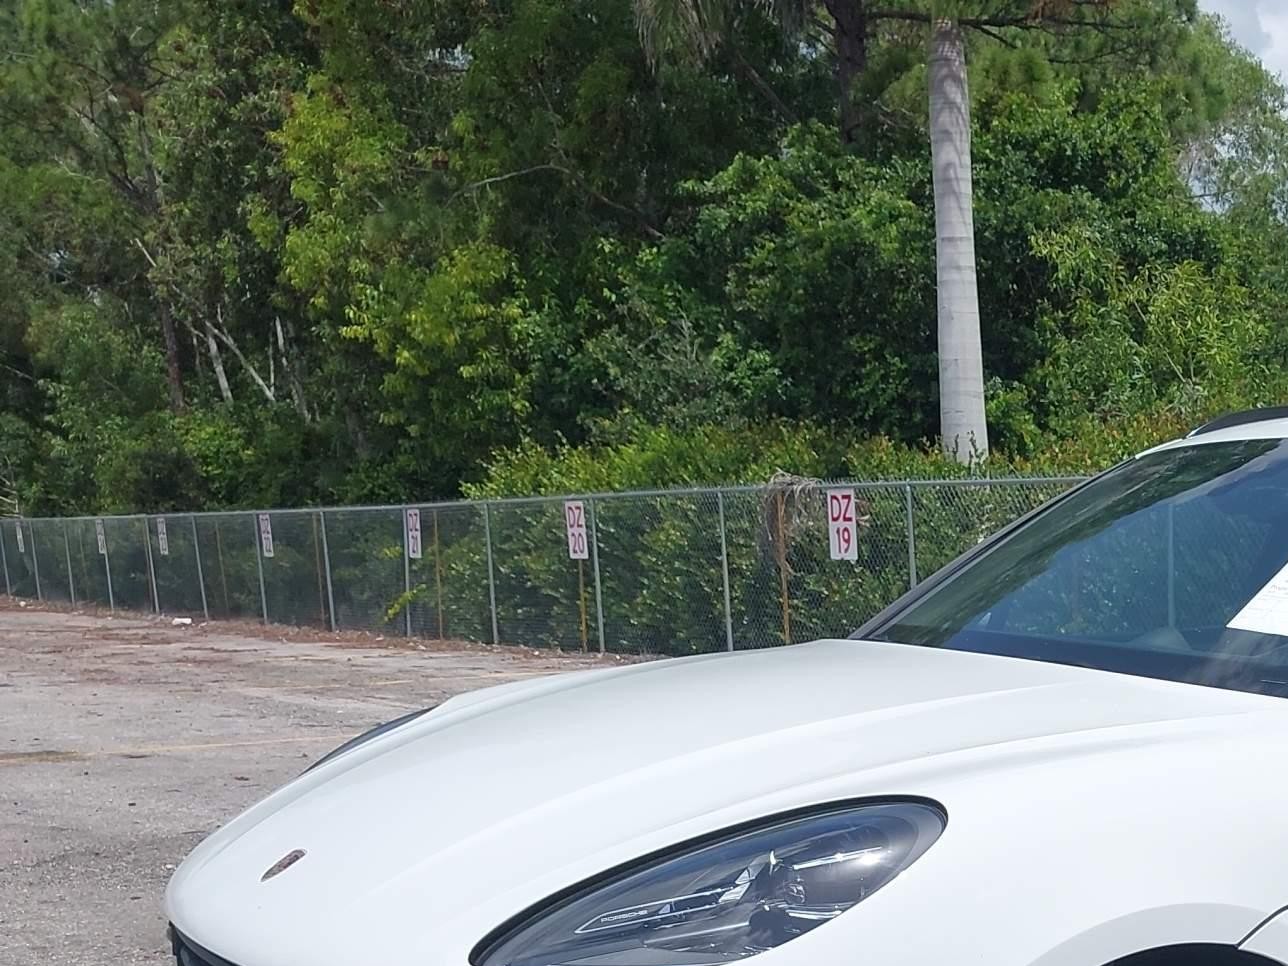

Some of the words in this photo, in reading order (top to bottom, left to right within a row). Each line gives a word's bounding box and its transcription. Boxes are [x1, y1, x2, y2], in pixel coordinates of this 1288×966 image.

[567, 506, 583, 528] DZ
[830, 494, 853, 522] DZ
[571, 532, 585, 554] 20
[836, 526, 851, 554] 19
[600, 910, 648, 922] PORSCHE
